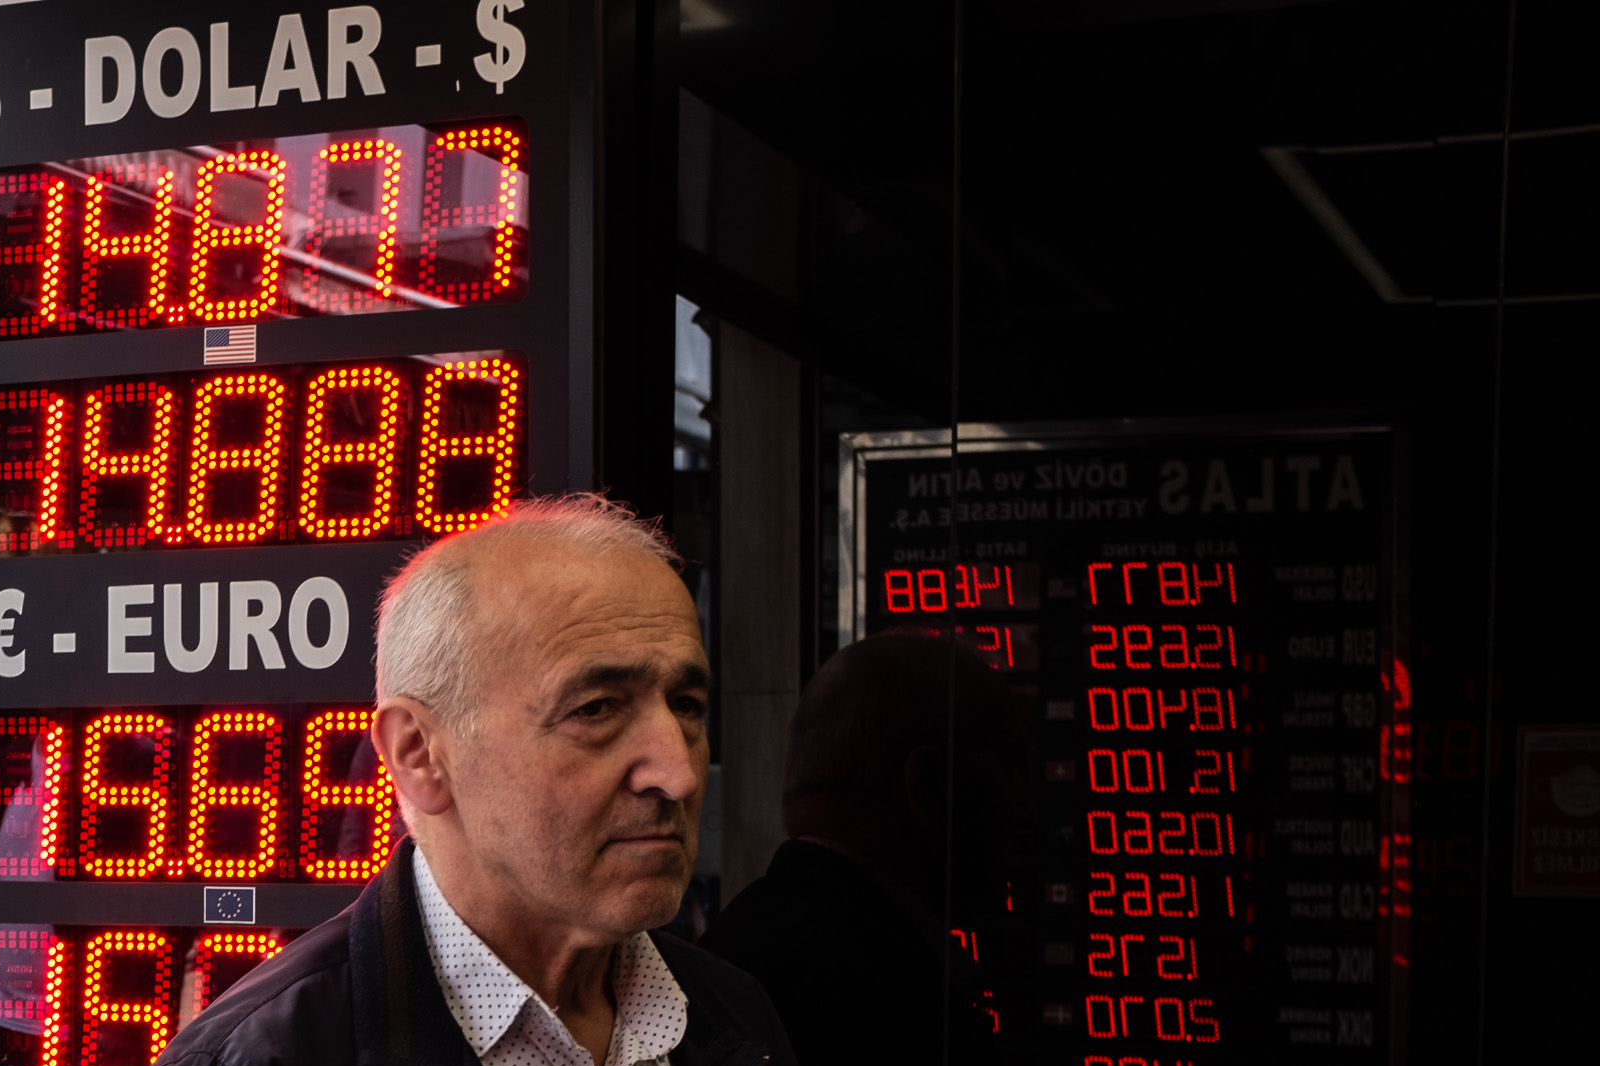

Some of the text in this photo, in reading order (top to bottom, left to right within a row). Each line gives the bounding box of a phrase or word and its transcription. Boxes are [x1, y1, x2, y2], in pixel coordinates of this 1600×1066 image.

[84, 5, 386, 126] DOLAR
[473, 0, 526, 94] $
[40, 127, 520, 323] 14.877
[40, 358, 519, 543] 14.888
[107, 576, 350, 674] EURO
